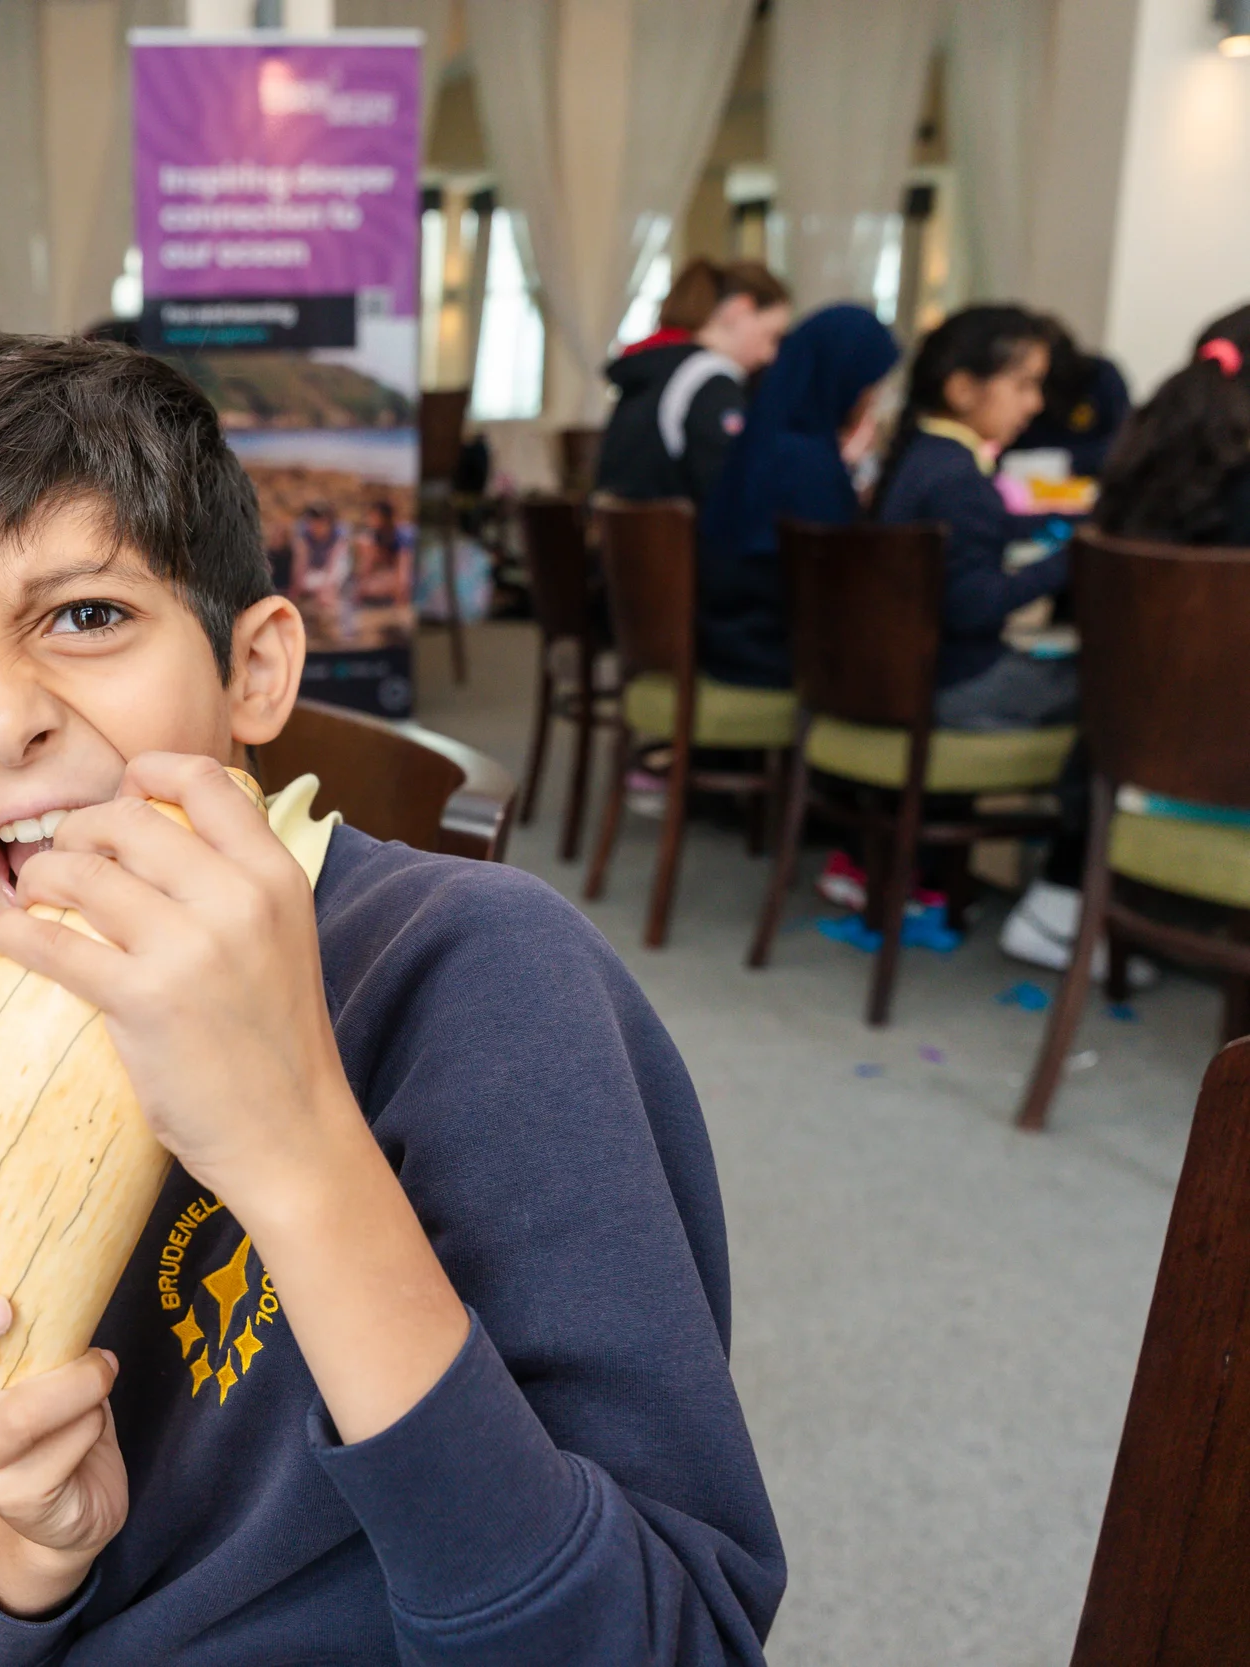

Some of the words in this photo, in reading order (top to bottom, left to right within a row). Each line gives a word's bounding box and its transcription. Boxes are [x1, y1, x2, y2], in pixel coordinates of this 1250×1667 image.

[160, 162, 291, 201] Inspiring
[295, 162, 393, 201] deeper
[160, 203, 324, 231] connection
[326, 202, 362, 231] to
[160, 242, 210, 269] our
[255, 1267, 279, 1326] OOL
